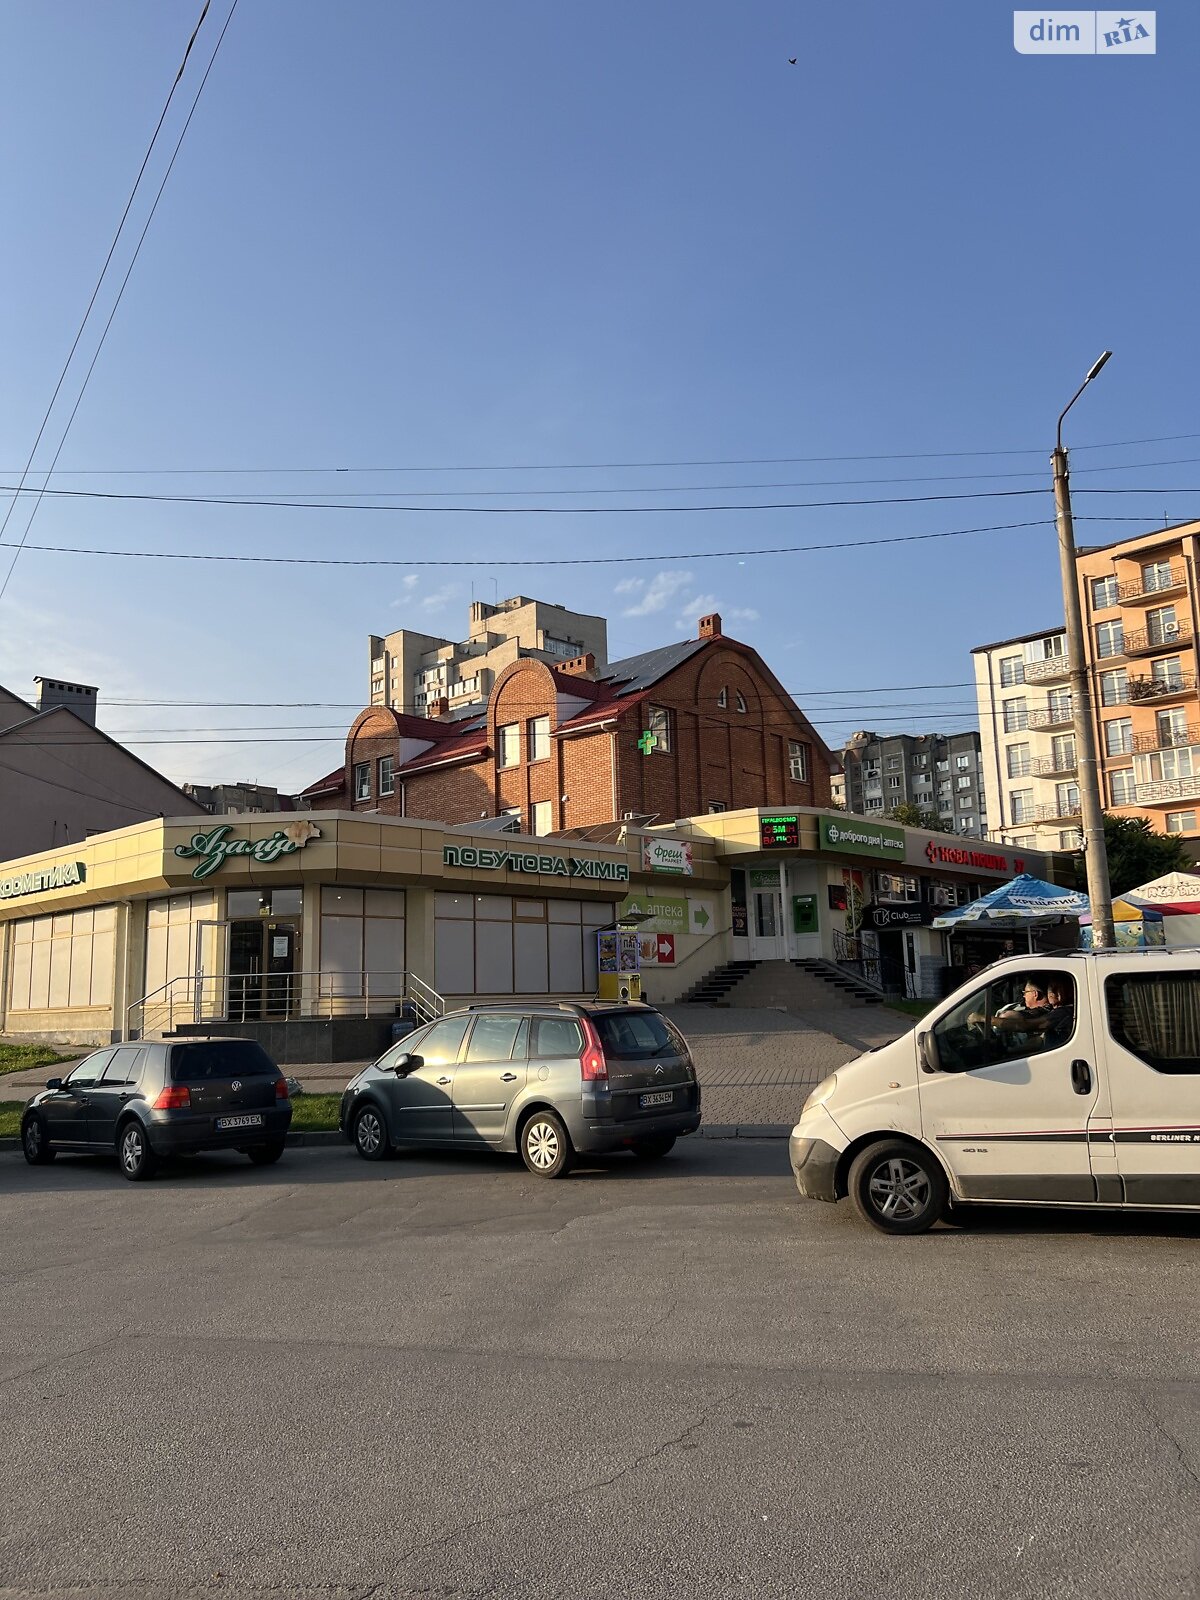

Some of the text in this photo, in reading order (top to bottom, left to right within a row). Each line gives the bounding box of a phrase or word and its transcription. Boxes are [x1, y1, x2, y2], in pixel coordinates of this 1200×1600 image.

[840, 830, 904, 849] доброго дня аптека
[174, 825, 300, 879] Азалія
[654, 845, 683, 860] Фреш
[939, 847, 969, 865] НОВА
[443, 844, 630, 881] ПОБУТОВА ХІМІЯ
[1013, 898, 1079, 907] ХРЕЩАТИК
[646, 904, 684, 918] аптека
[891, 912, 909, 920] Club
[221, 1115, 261, 1127] BX 3769 EX
[1150, 1134, 1191, 1142] BERLINER
